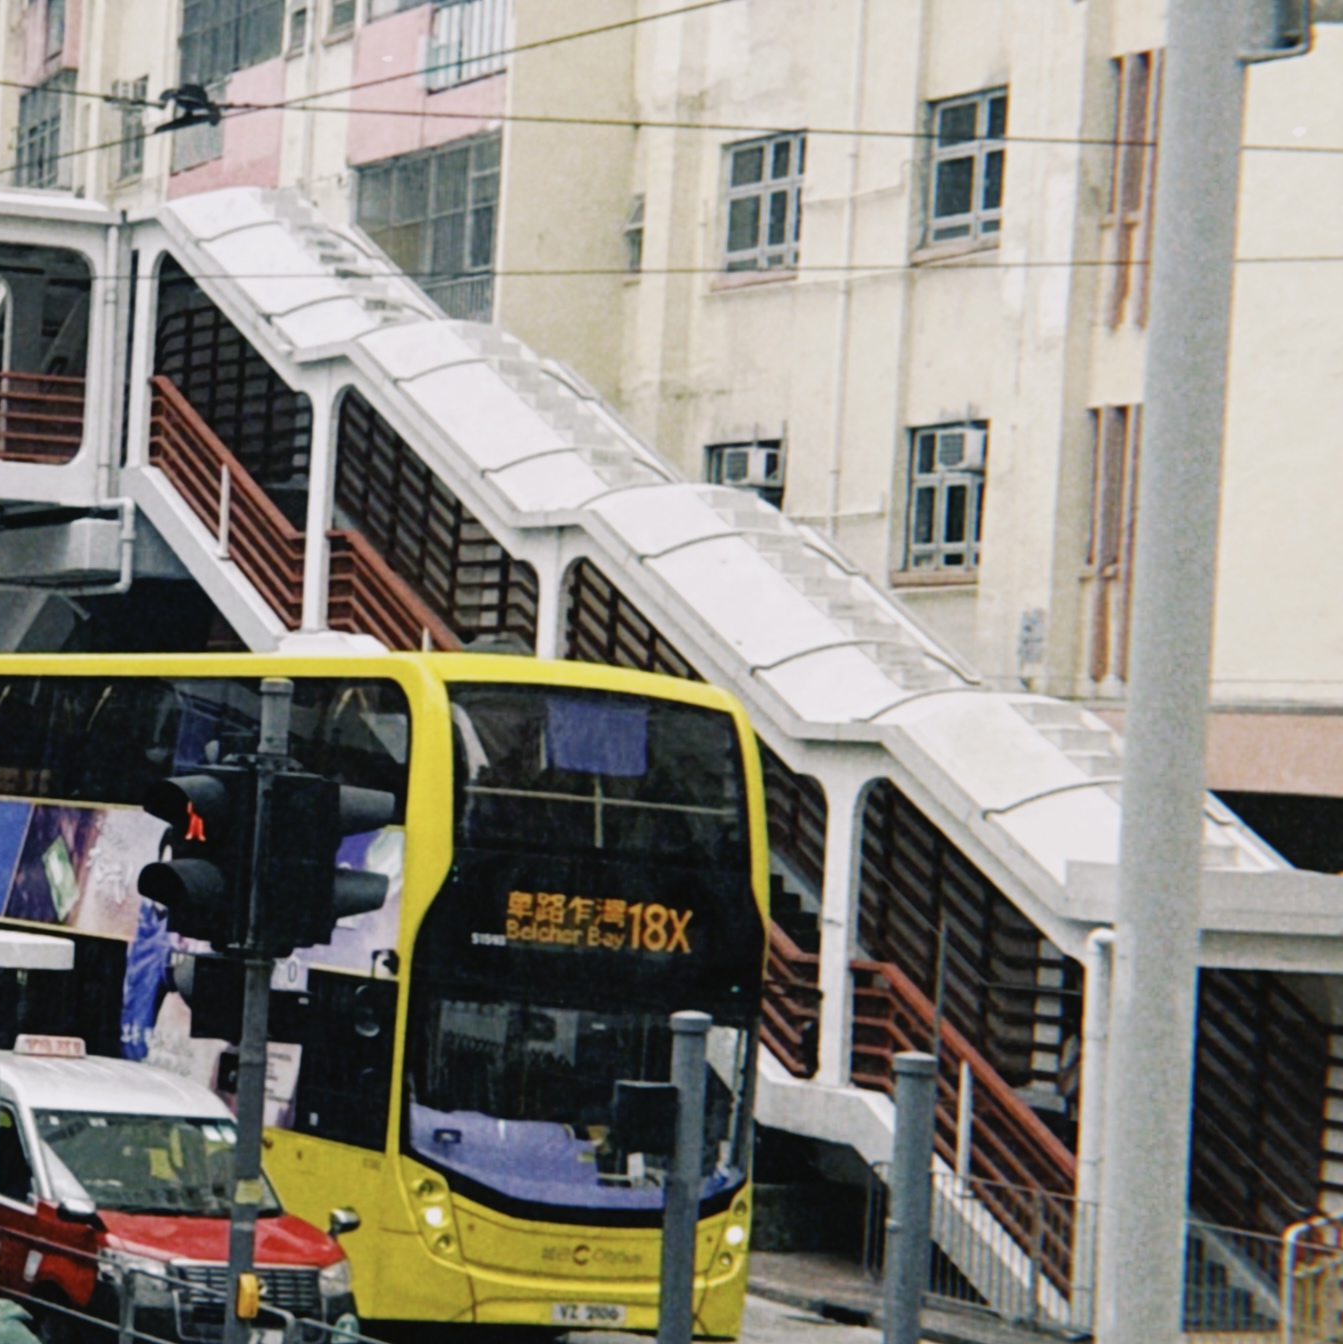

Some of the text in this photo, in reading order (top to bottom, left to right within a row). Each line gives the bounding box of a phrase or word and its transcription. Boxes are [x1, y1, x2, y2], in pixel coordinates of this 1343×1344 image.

[507, 890, 628, 928] 卑路乍灣
[628, 902, 693, 954] 18X
[505, 919, 584, 945] Belcher
[587, 925, 625, 951] Bay
